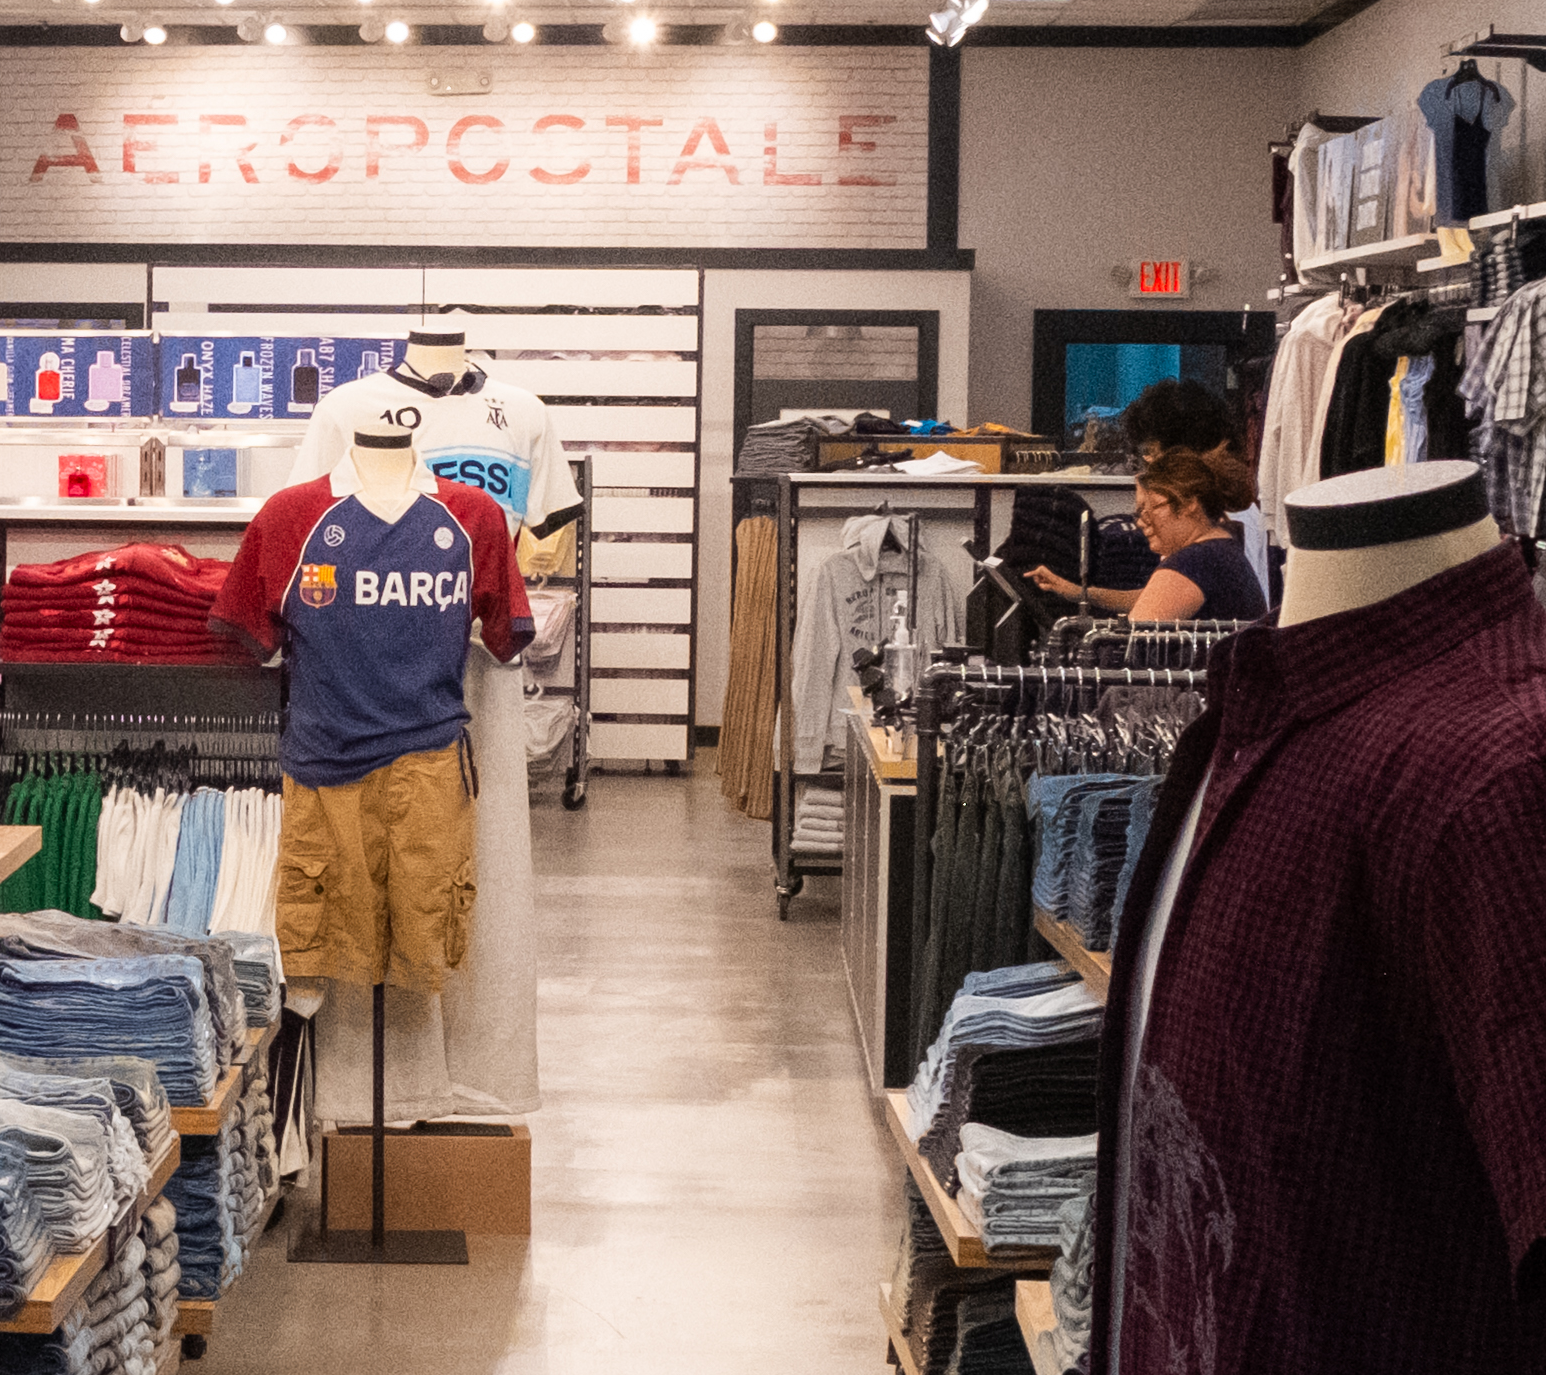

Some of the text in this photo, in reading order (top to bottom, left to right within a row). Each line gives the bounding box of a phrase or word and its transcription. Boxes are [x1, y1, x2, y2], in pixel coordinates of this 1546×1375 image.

[1140, 261, 1181, 292] EXIT
[61, 337, 75, 400] MA CHERIE
[120, 337, 132, 375] CELESTIAL
[200, 340, 214, 416] ONYX HAZE
[259, 337, 273, 420] FROZEN WAVES
[318, 338, 335, 399] A87 SHA
[380, 406, 422, 430] 10
[355, 569, 468, 612] BARÇA
